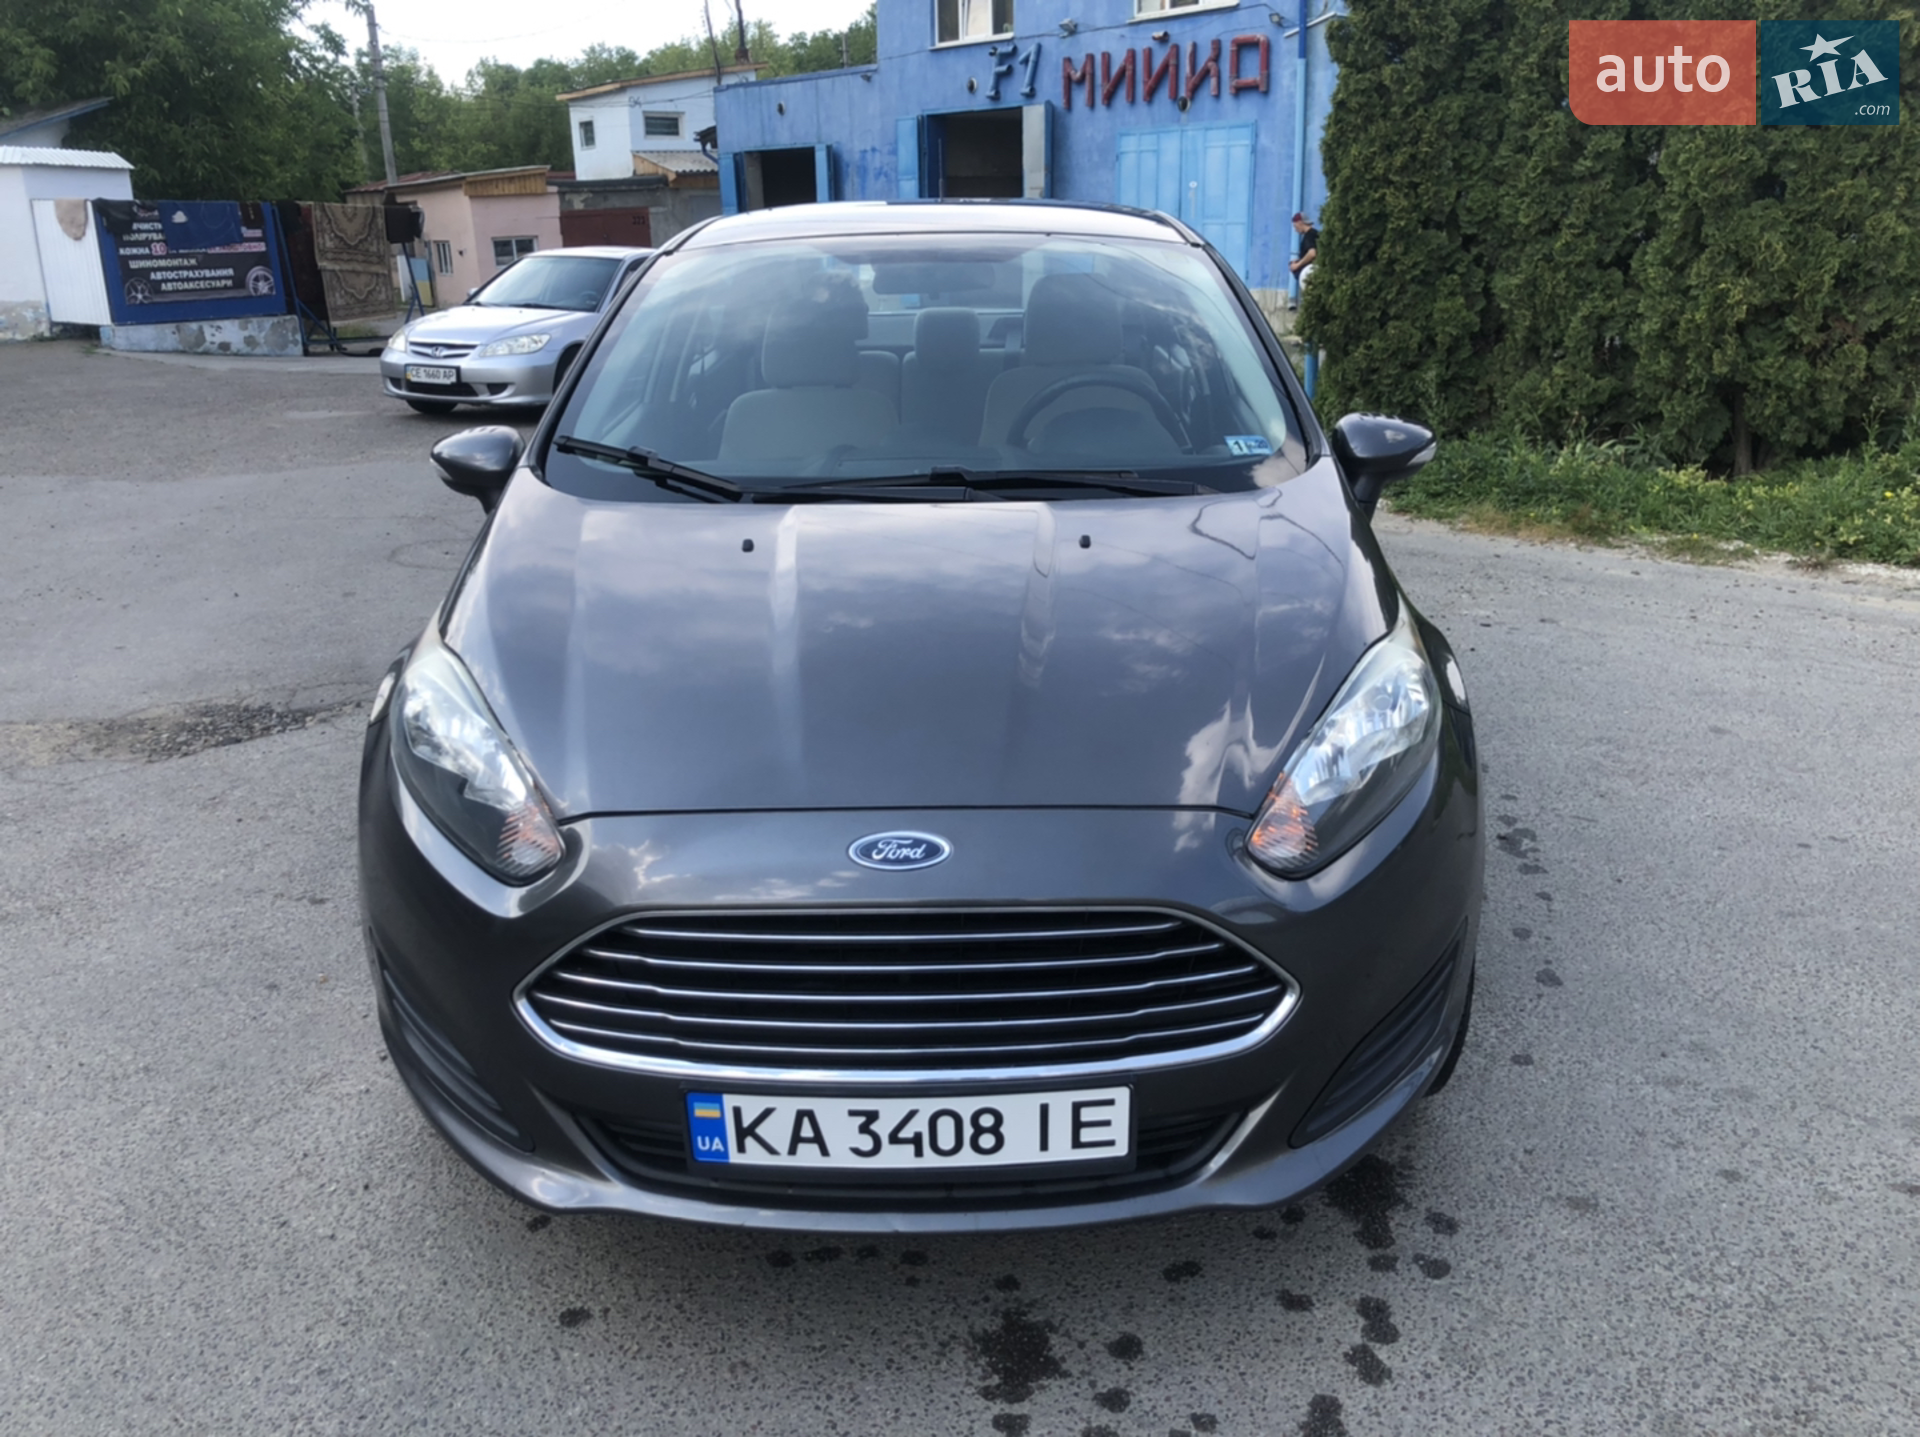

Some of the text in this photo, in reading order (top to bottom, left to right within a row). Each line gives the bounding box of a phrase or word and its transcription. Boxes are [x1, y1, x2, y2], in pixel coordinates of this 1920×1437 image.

[986, 42, 1042, 100] F1
[151, 242, 168, 255] 10
[128, 257, 198, 269] ШИНОМОНТАЖ
[150, 268, 235, 281] АВТОСТРАХУВАННЯ
[160, 279, 233, 292] АВТОАКСЕСУАРИ
[410, 367, 421, 378] CE
[871, 838, 928, 861] Ford
[731, 1098, 1117, 1159] KA 3408 IE
[696, 1135, 726, 1153] UA
